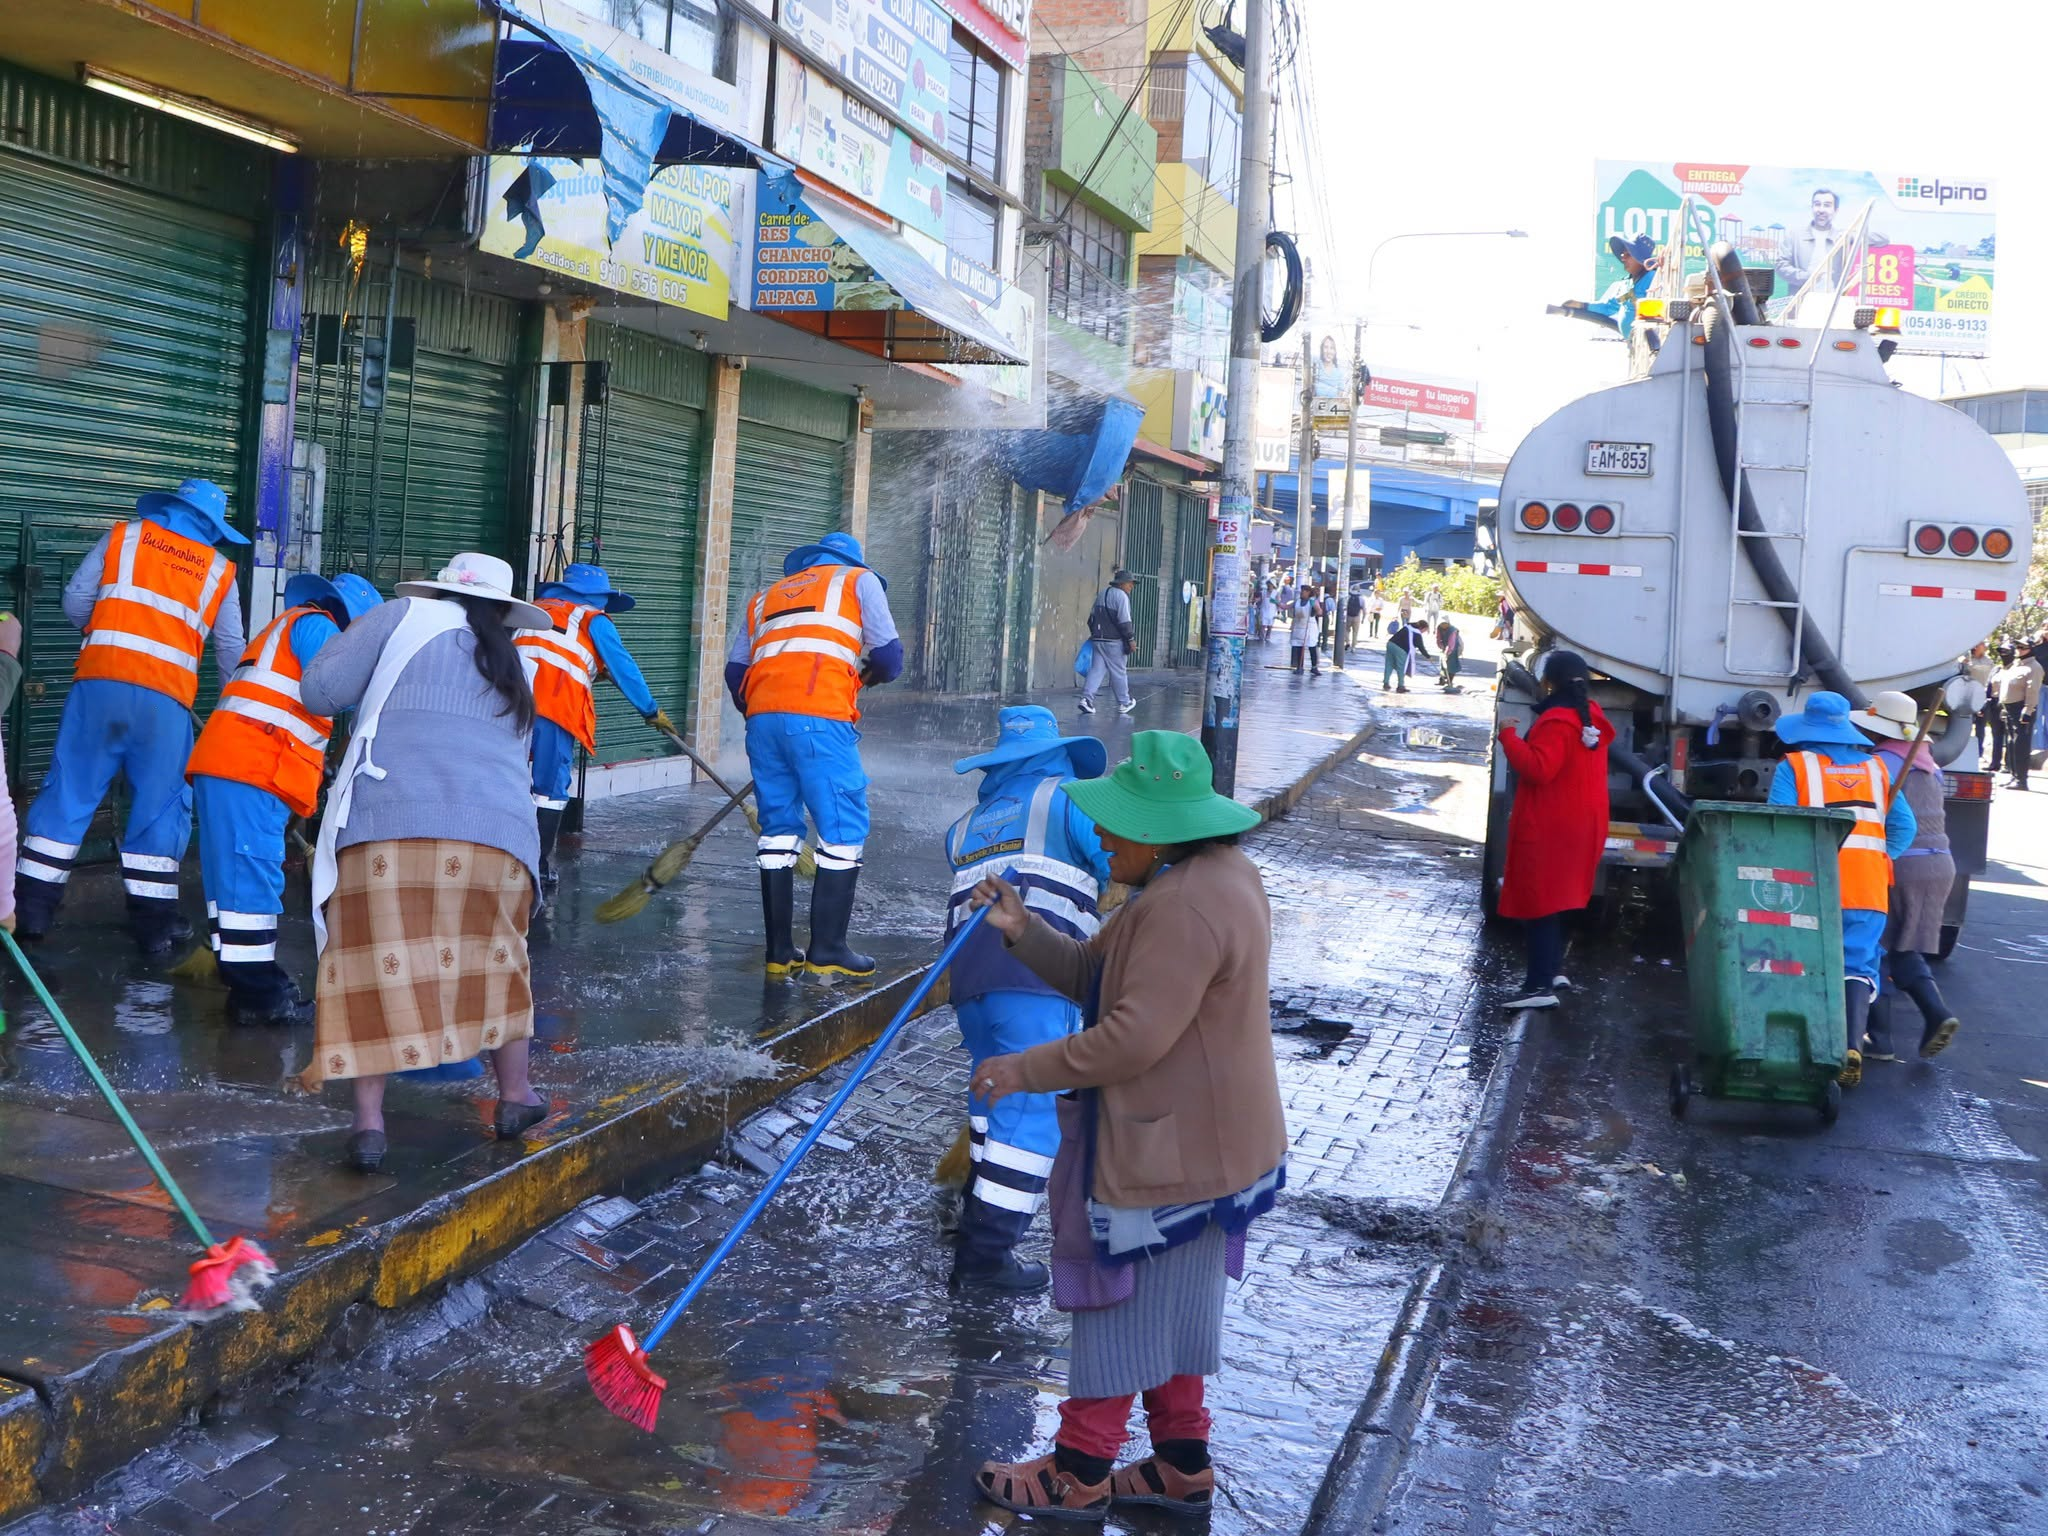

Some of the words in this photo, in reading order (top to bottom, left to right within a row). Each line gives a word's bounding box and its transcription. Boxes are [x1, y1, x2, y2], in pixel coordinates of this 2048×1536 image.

[913, 1, 948, 54] AVELINO
[877, 28, 908, 69] SALUD
[630, 58, 684, 96] DISTRIBUIDOR
[684, 85, 729, 115] AUTORIZADO
[859, 57, 897, 103] RIQUEZA
[846, 93, 890, 139] FELICIDAD
[1688, 169, 1736, 183] ENTREGA
[681, 167, 701, 197] AL
[702, 172, 731, 206] POR
[1683, 181, 1740, 195] INMEDIATA
[1920, 178, 1988, 206] elpino
[651, 193, 702, 238] MAYOR
[760, 213, 792, 226] Carne
[794, 212, 810, 226] de:
[760, 227, 789, 242] RES
[643, 234, 654, 263] Y
[656, 239, 708, 282] MENOR
[758, 248, 833, 263] CHANCHO
[537, 248, 577, 272] Pedidos
[577, 261, 590, 275] al:
[599, 259, 627, 287] 910
[632, 272, 657, 296] 556
[662, 278, 688, 304] 605
[758, 270, 828, 284] CORDERO
[952, 257, 969, 286] CLUB
[970, 268, 997, 300] AVELINO
[1866, 253, 1899, 285] 18
[757, 291, 817, 305] ALPACA
[1947, 299, 1989, 311] DIRECTO
[1954, 290, 1987, 300] CRÉDITO
[1904, 316, 1988, 332] (054)36-9133
[1370, 380, 1389, 392] Haz
[1390, 385, 1420, 397] crecer
[1425, 389, 1435, 400] tu
[1608, 444, 1631, 452] PERU
[1591, 456, 1598, 468] E
[1598, 450, 1648, 470] AM-853
[142, 531, 206, 568] Bustamantinos
[170, 563, 193, 576] como
